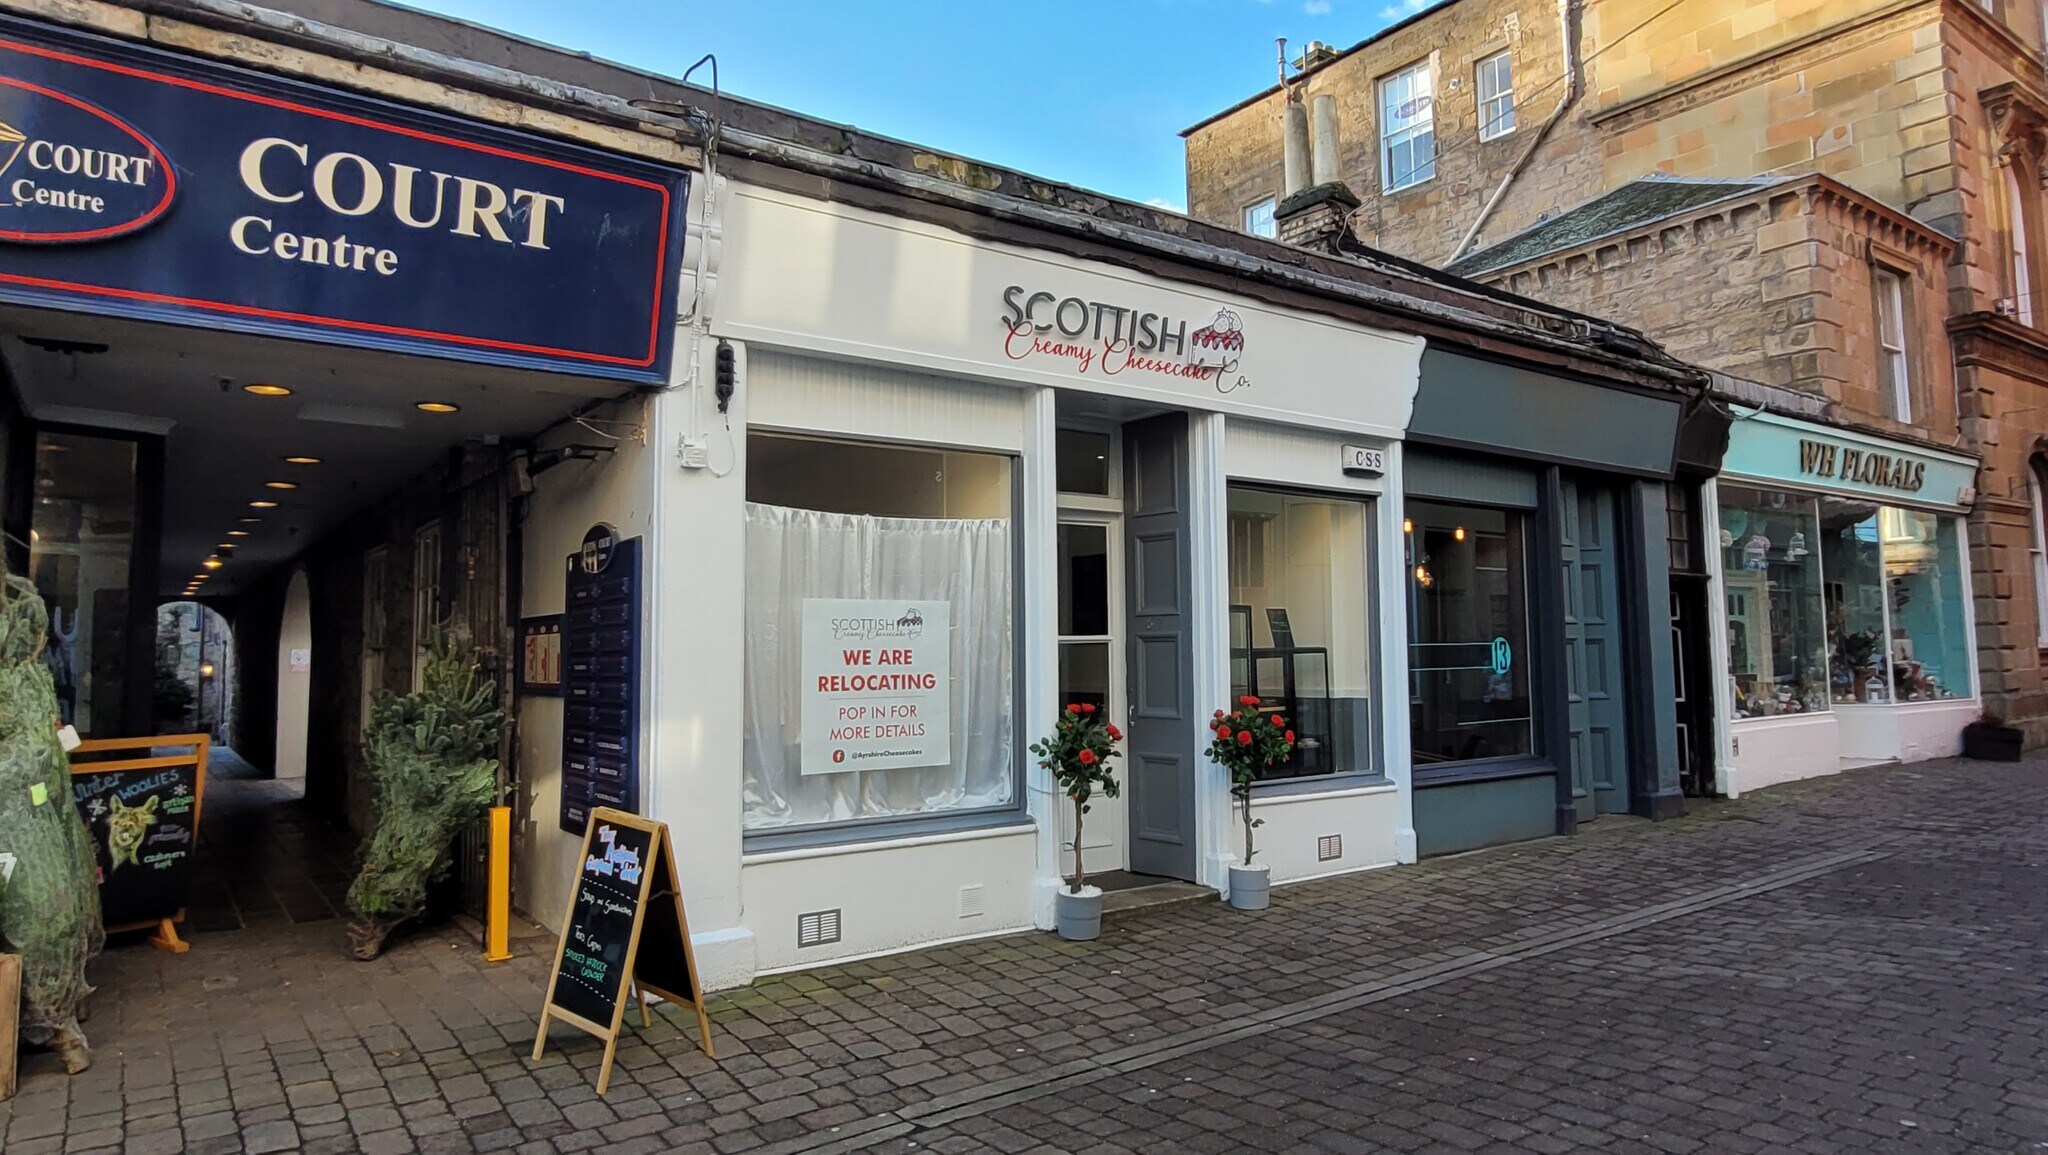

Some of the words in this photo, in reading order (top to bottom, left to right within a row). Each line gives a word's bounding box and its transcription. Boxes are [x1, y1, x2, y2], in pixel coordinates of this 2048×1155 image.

[28, 140, 152, 187] COURT
[11, 178, 105, 213] Centre
[238, 137, 565, 251] COURT
[229, 216, 399, 275] Centre
[1001, 285, 1187, 356] SCOTTISH
[1004, 320, 1097, 374] Creamy
[1101, 336, 1213, 381] Cheesecake
[1799, 438, 1840, 477] WH
[1839, 447, 1926, 492] FLORALS
[831, 618, 895, 632] SCOTTISH
[843, 650, 872, 666] WE
[877, 649, 913, 666] ARE
[817, 674, 937, 693] RELOCATING
[838, 707, 867, 721] POP
[871, 705, 886, 719] IN
[890, 704, 918, 719] FOR
[829, 726, 871, 741] MORE
[875, 723, 926, 738] DETAILS
[851, 749, 923, 760] @AyrshireCheesecakes
